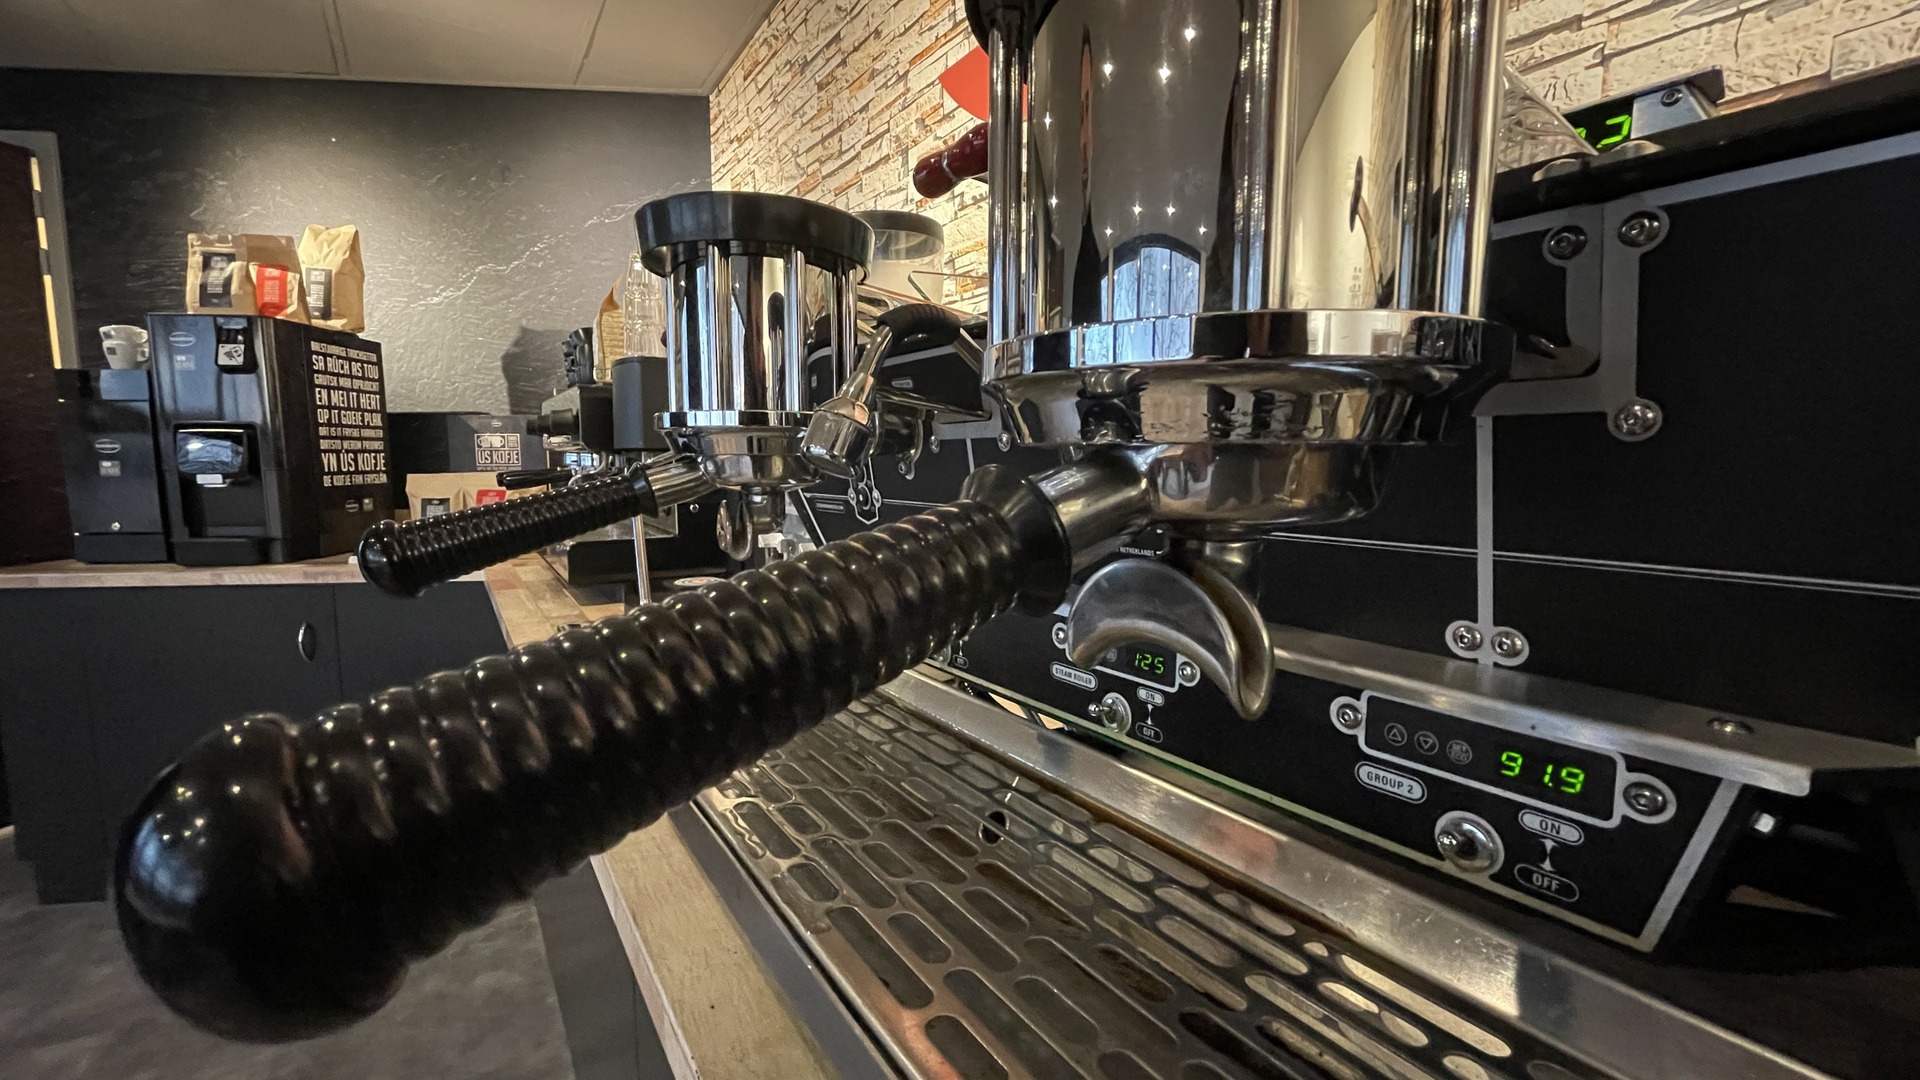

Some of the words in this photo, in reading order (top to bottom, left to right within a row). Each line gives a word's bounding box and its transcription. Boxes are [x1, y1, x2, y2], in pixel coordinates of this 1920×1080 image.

[312, 354, 325, 371] SA
[326, 355, 350, 375] RÛCH
[351, 361, 363, 377] AS
[363, 363, 379, 379] TOU
[315, 387, 329, 406] EN
[330, 389, 348, 408] MEI
[349, 391, 357, 409] IT
[360, 392, 381, 411] HERT
[317, 408, 329, 424] OP
[331, 409, 339, 424] IT
[340, 410, 363, 426] GOEIE
[363, 412, 383, 427] PLAK
[321, 452, 338, 472] YN
[357, 452, 386, 471] KOFJE
[492, 450, 519, 464] KOFJE
[323, 475, 333, 487] DE
[332, 474, 351, 486] KOFJE
[1119, 546, 1155, 557] NETHERLANDS
[1054, 667, 1073, 681] STEAM
[1073, 671, 1093, 686] BOILER
[1144, 691, 1156, 702] ON
[1142, 726, 1155, 738] OFF
[1501, 751, 1586, 795] 91.9
[1366, 770, 1404, 792] GROUP
[1406, 784, 1415, 796] 2
[1539, 819, 1562, 837] ON
[1531, 872, 1561, 893] OFF
